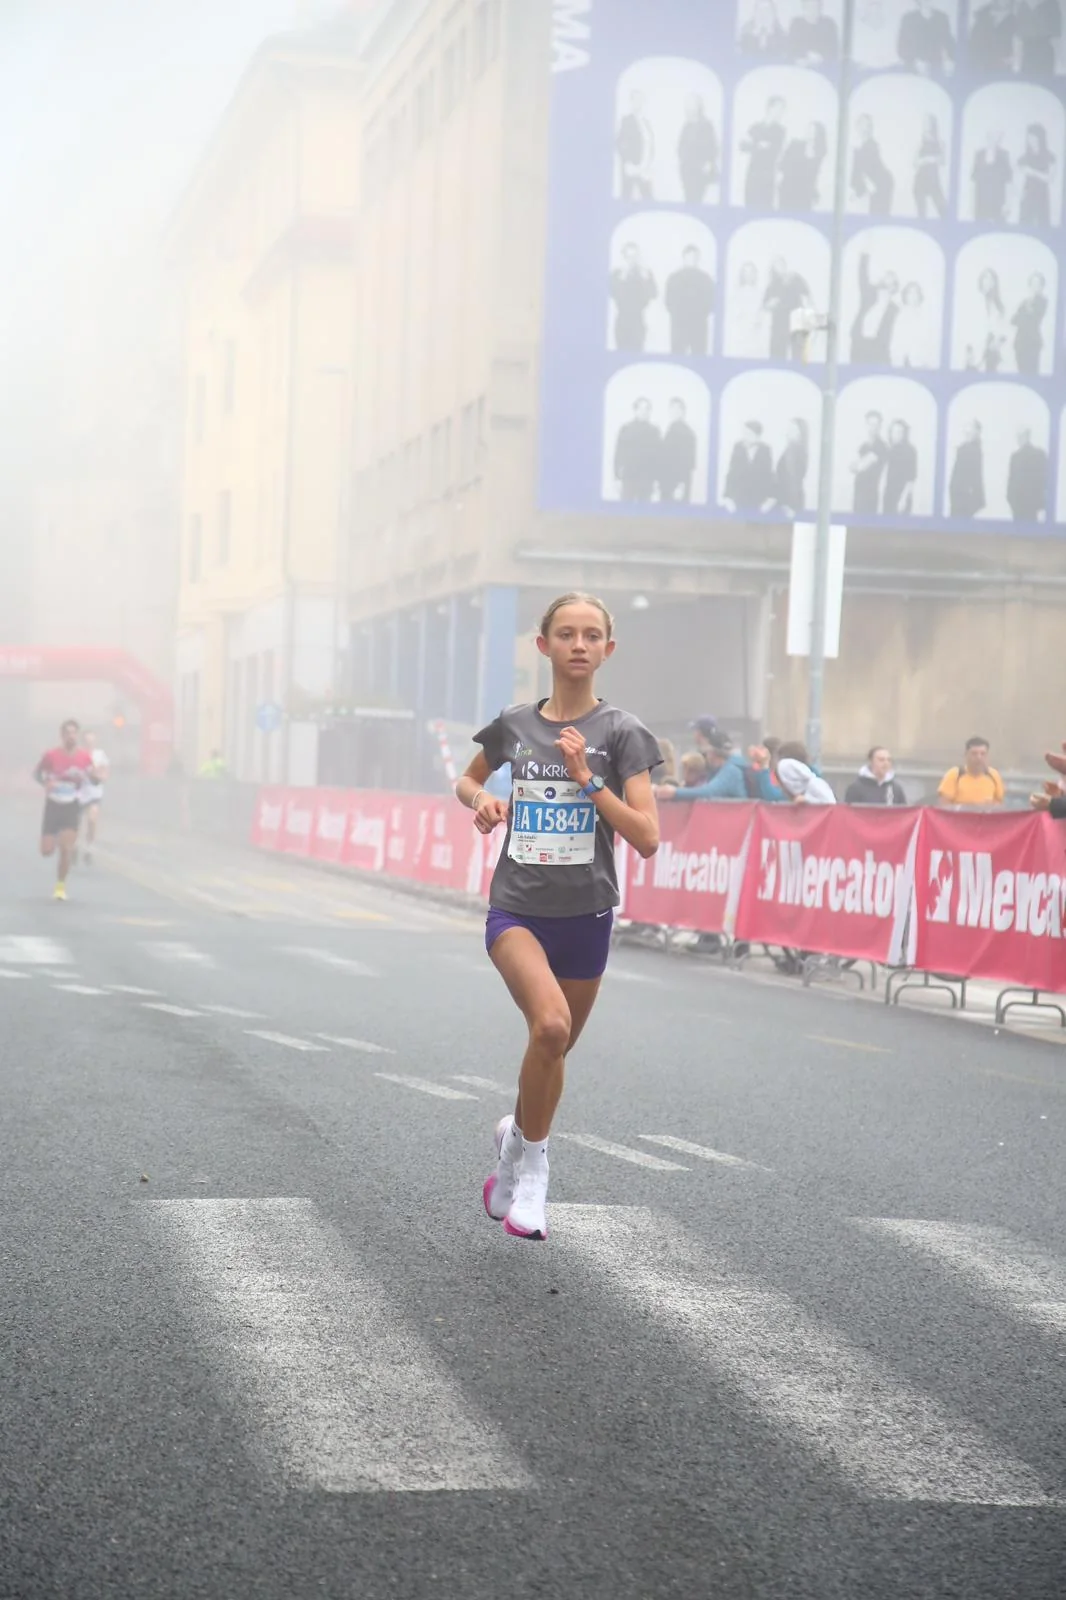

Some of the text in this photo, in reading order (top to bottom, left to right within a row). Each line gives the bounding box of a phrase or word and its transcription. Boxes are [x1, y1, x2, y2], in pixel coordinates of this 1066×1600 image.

[542, 764, 570, 778] KRK
[521, 806, 530, 830] A
[535, 807, 591, 832] 15847
